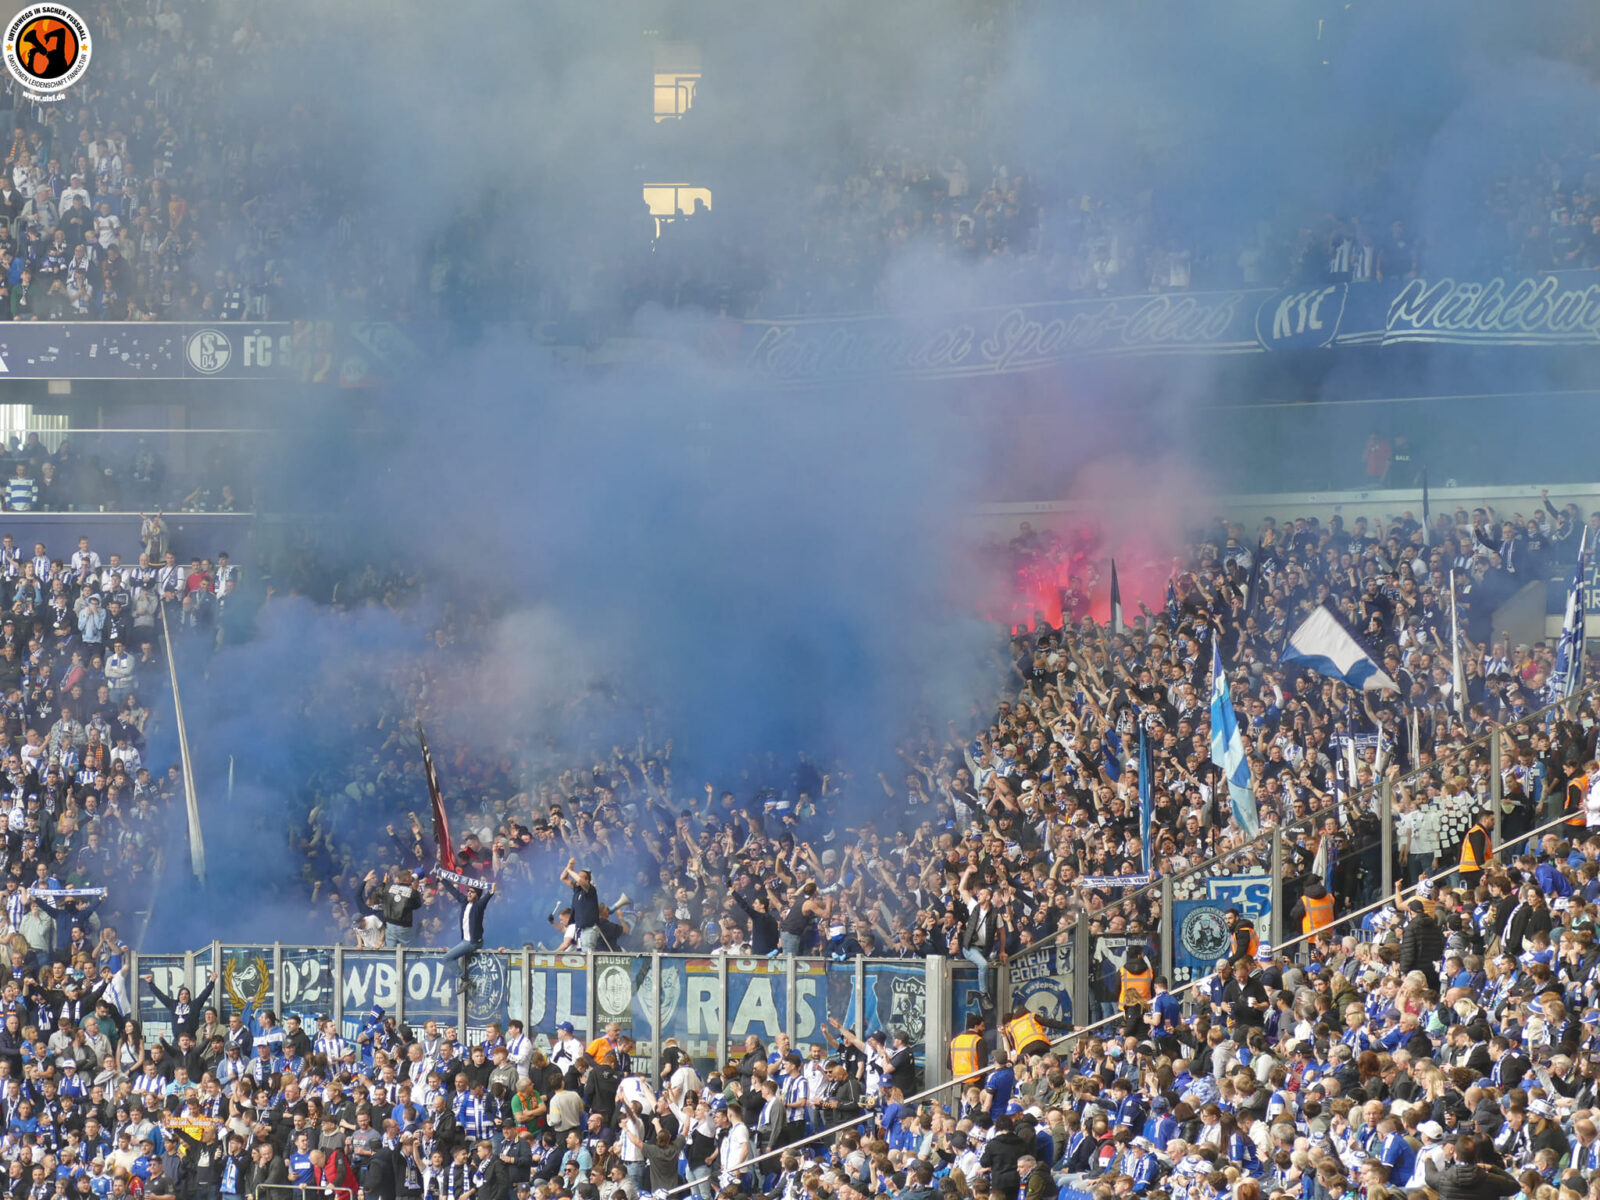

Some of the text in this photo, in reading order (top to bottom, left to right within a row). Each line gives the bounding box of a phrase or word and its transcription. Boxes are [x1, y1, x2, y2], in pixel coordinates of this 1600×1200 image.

[1386, 275, 1600, 340] Mühlbur
[243, 335, 272, 367] FC
[467, 878, 489, 889] BOYS
[281, 958, 321, 1004] 02
